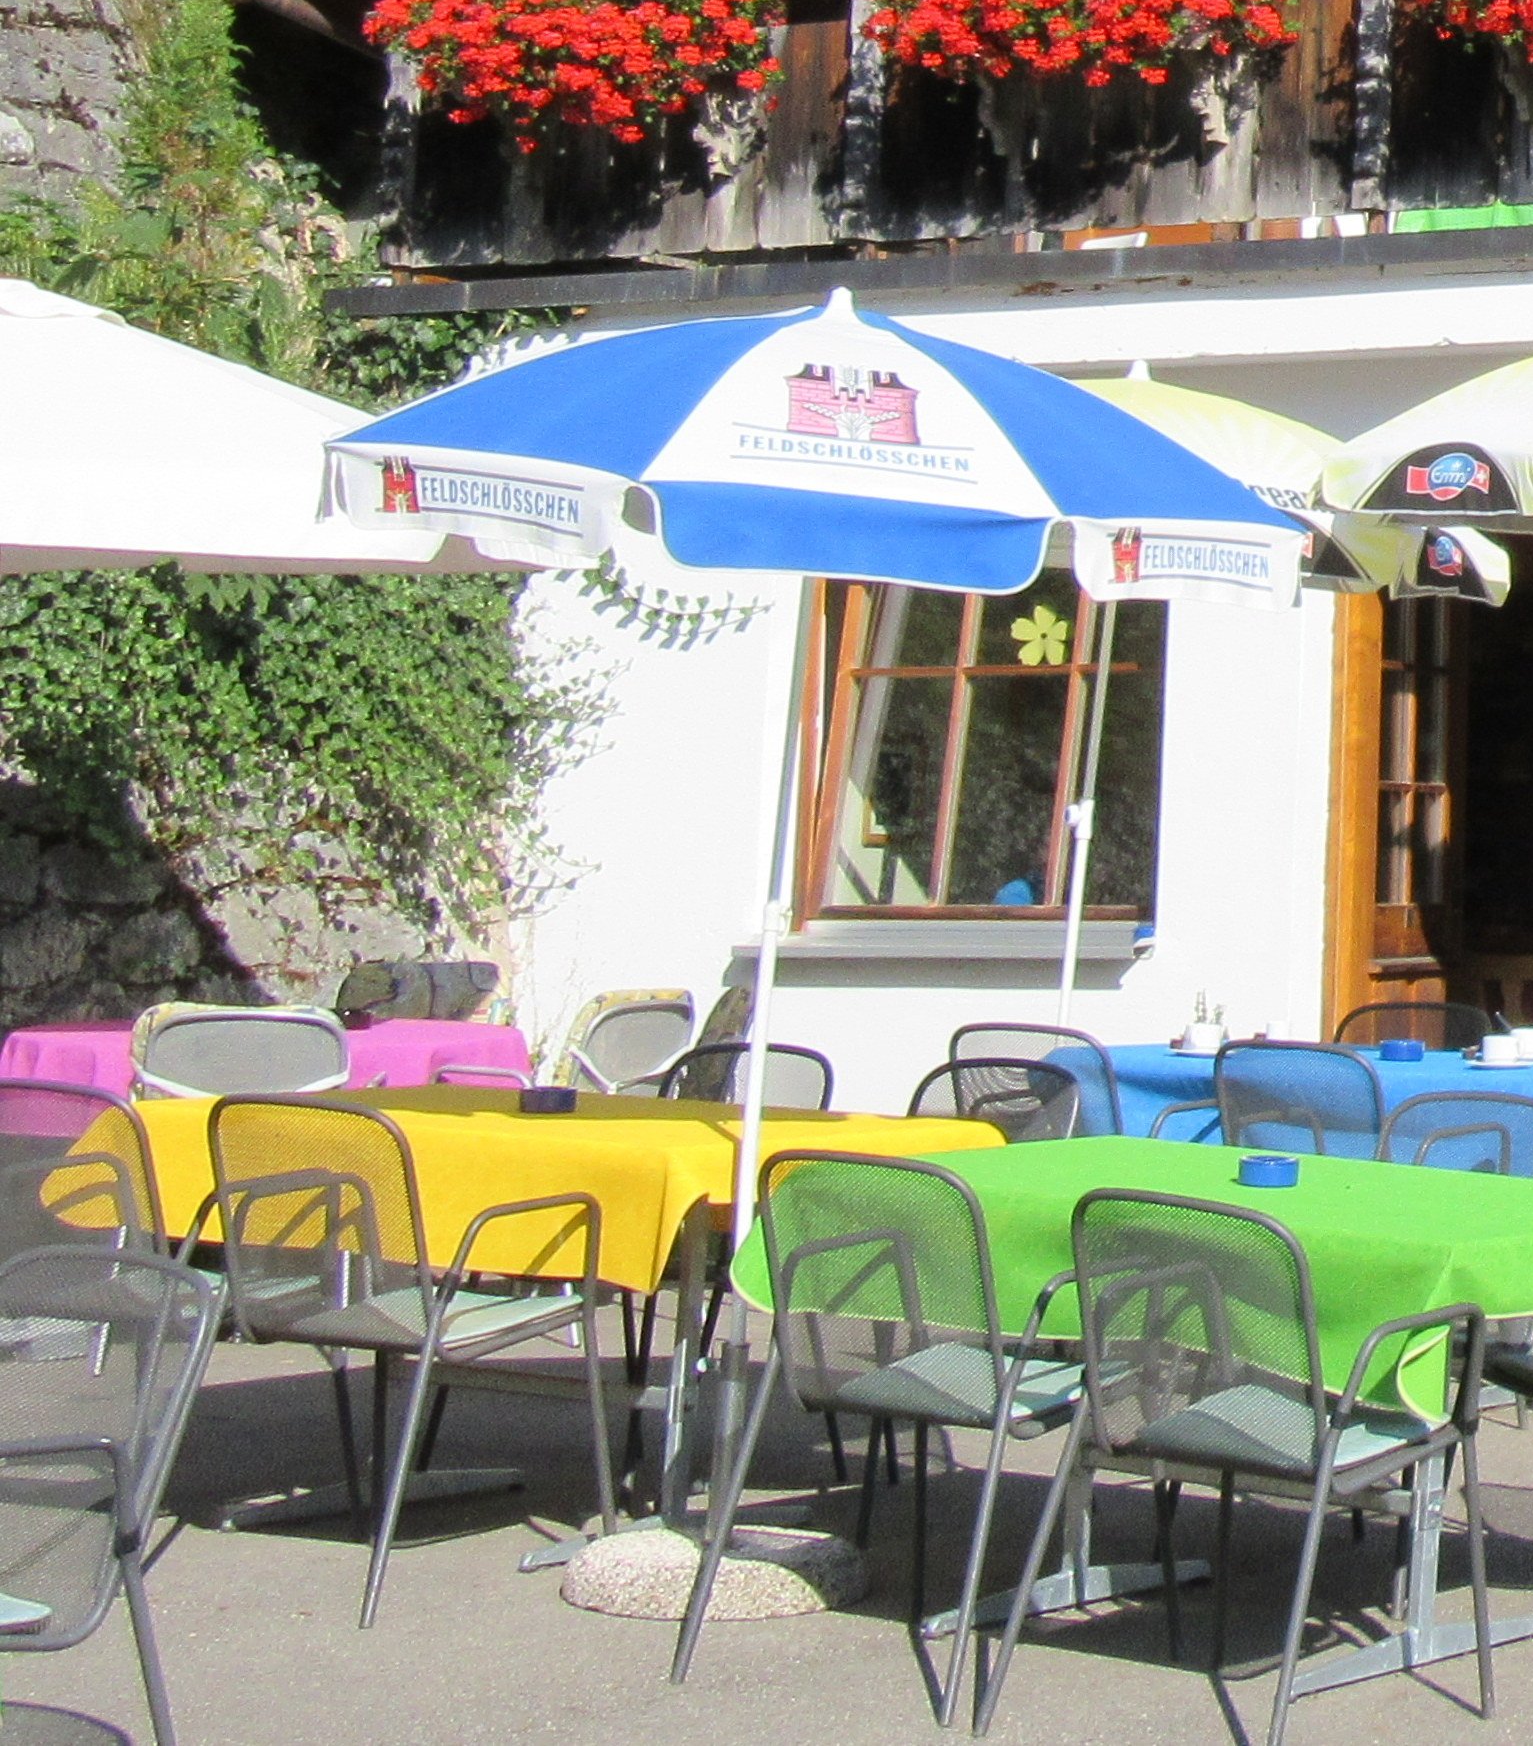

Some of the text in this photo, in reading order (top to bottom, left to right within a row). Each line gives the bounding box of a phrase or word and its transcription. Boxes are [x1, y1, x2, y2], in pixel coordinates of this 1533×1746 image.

[739, 433, 970, 472] FELDSCHLÖSSCHEN
[420, 476, 580, 525] FELDSCHLÖSSCHEN
[1143, 543, 1270, 579] FELDSCHLÖSSCHEN
